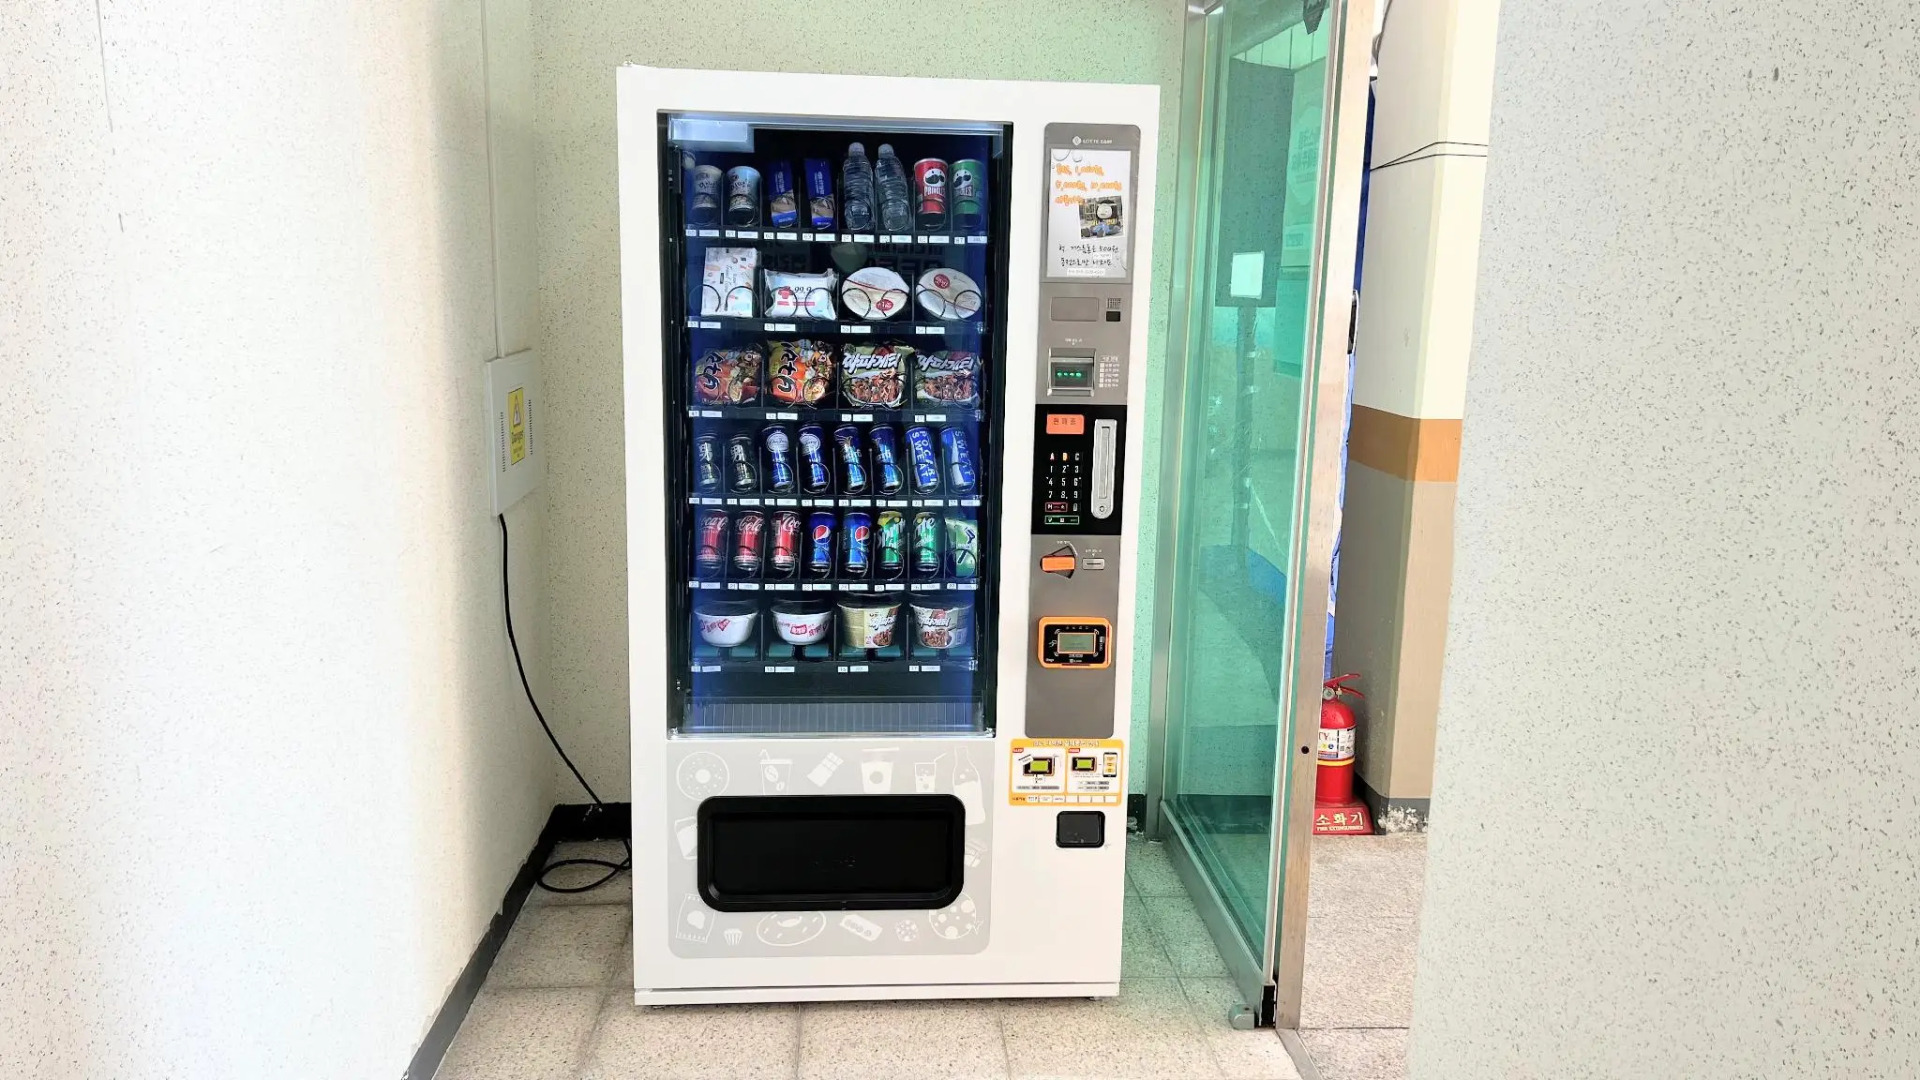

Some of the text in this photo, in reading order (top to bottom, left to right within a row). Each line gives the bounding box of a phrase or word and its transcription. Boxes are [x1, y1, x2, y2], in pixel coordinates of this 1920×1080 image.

[842, 353, 902, 374] 짜파게티
[917, 354, 974, 372] 짜파게티
[911, 432, 930, 478] SWEAT
[918, 430, 938, 483] POCARI
[954, 430, 971, 475] SWEAT
[1062, 466, 1067, 474] 2
[1074, 466, 1079, 474] 3
[1048, 478, 1054, 486] 4
[1061, 478, 1066, 486] 5
[1048, 490, 1078, 499] 7 8 9
[1316, 812, 1364, 826] 소화기
